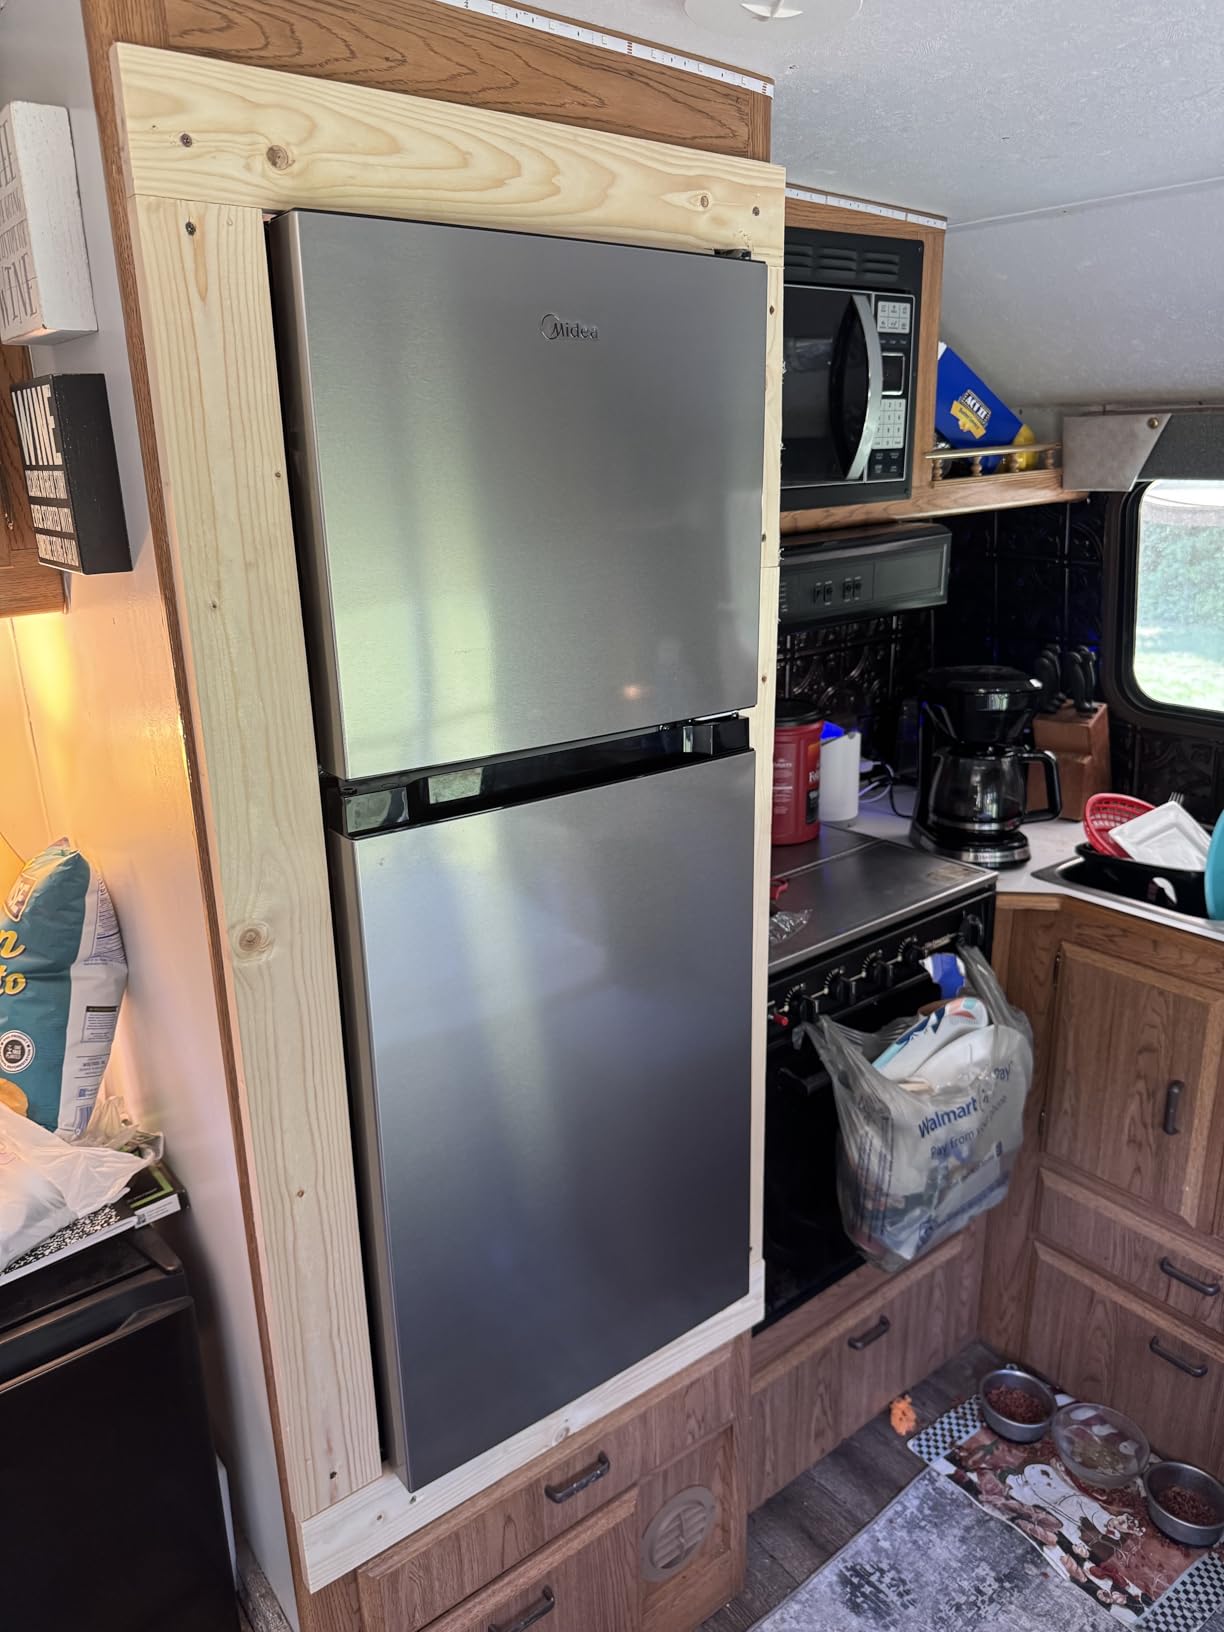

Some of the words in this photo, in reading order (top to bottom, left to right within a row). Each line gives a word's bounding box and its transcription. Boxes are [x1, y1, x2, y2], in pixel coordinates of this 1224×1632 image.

[544, 317, 598, 339] Midea
[12, 384, 63, 465] WINE
[918, 1096, 978, 1139] Walmart
[949, 1131, 975, 1150] from
